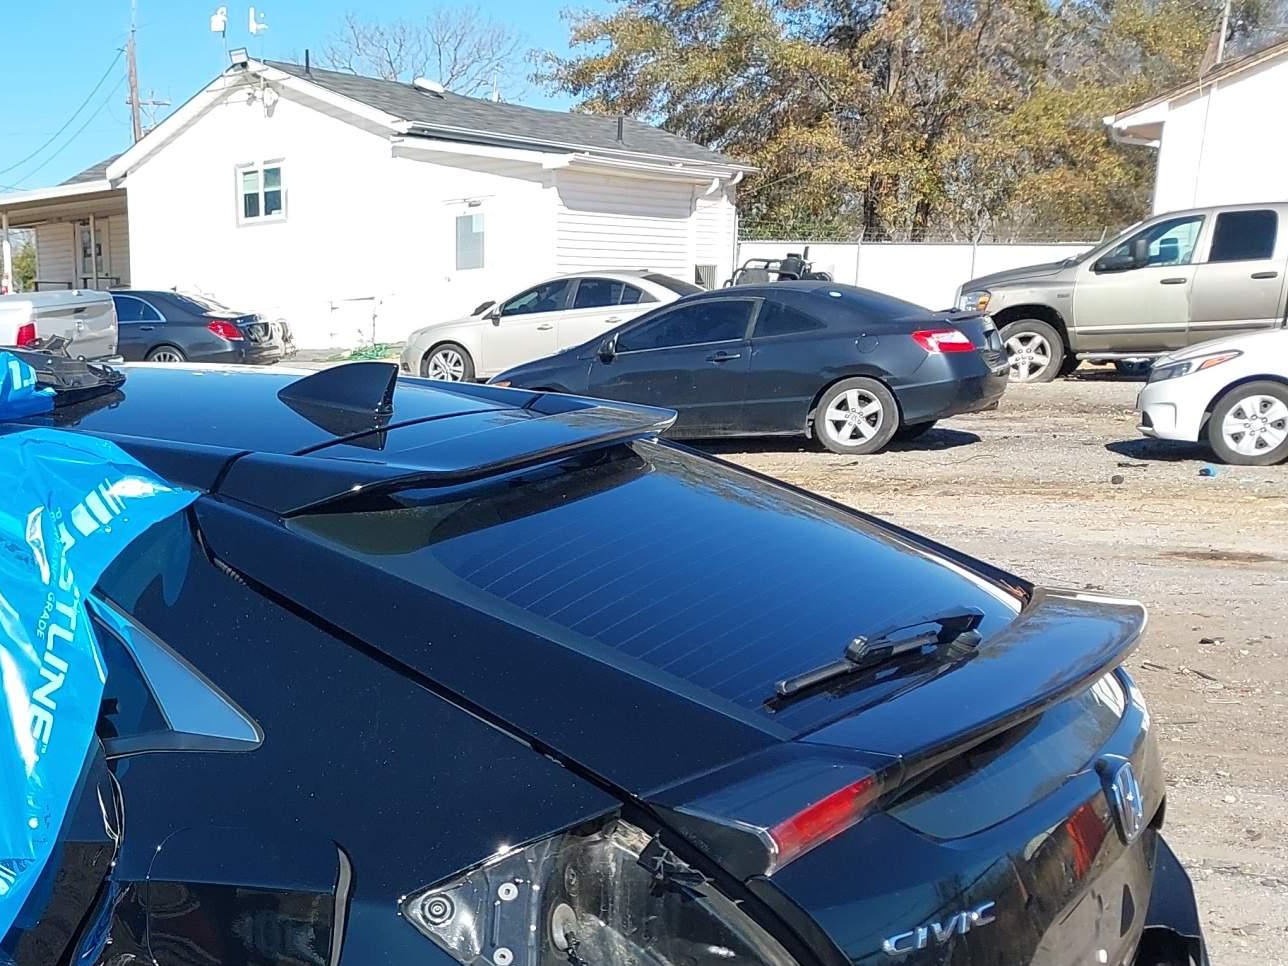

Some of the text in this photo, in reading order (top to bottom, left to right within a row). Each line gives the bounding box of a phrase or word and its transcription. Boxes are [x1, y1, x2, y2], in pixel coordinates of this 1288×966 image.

[30, 521, 79, 746] ASTLINE
[37, 591, 55, 640] GRADE
[882, 901, 996, 955] CIVIC
